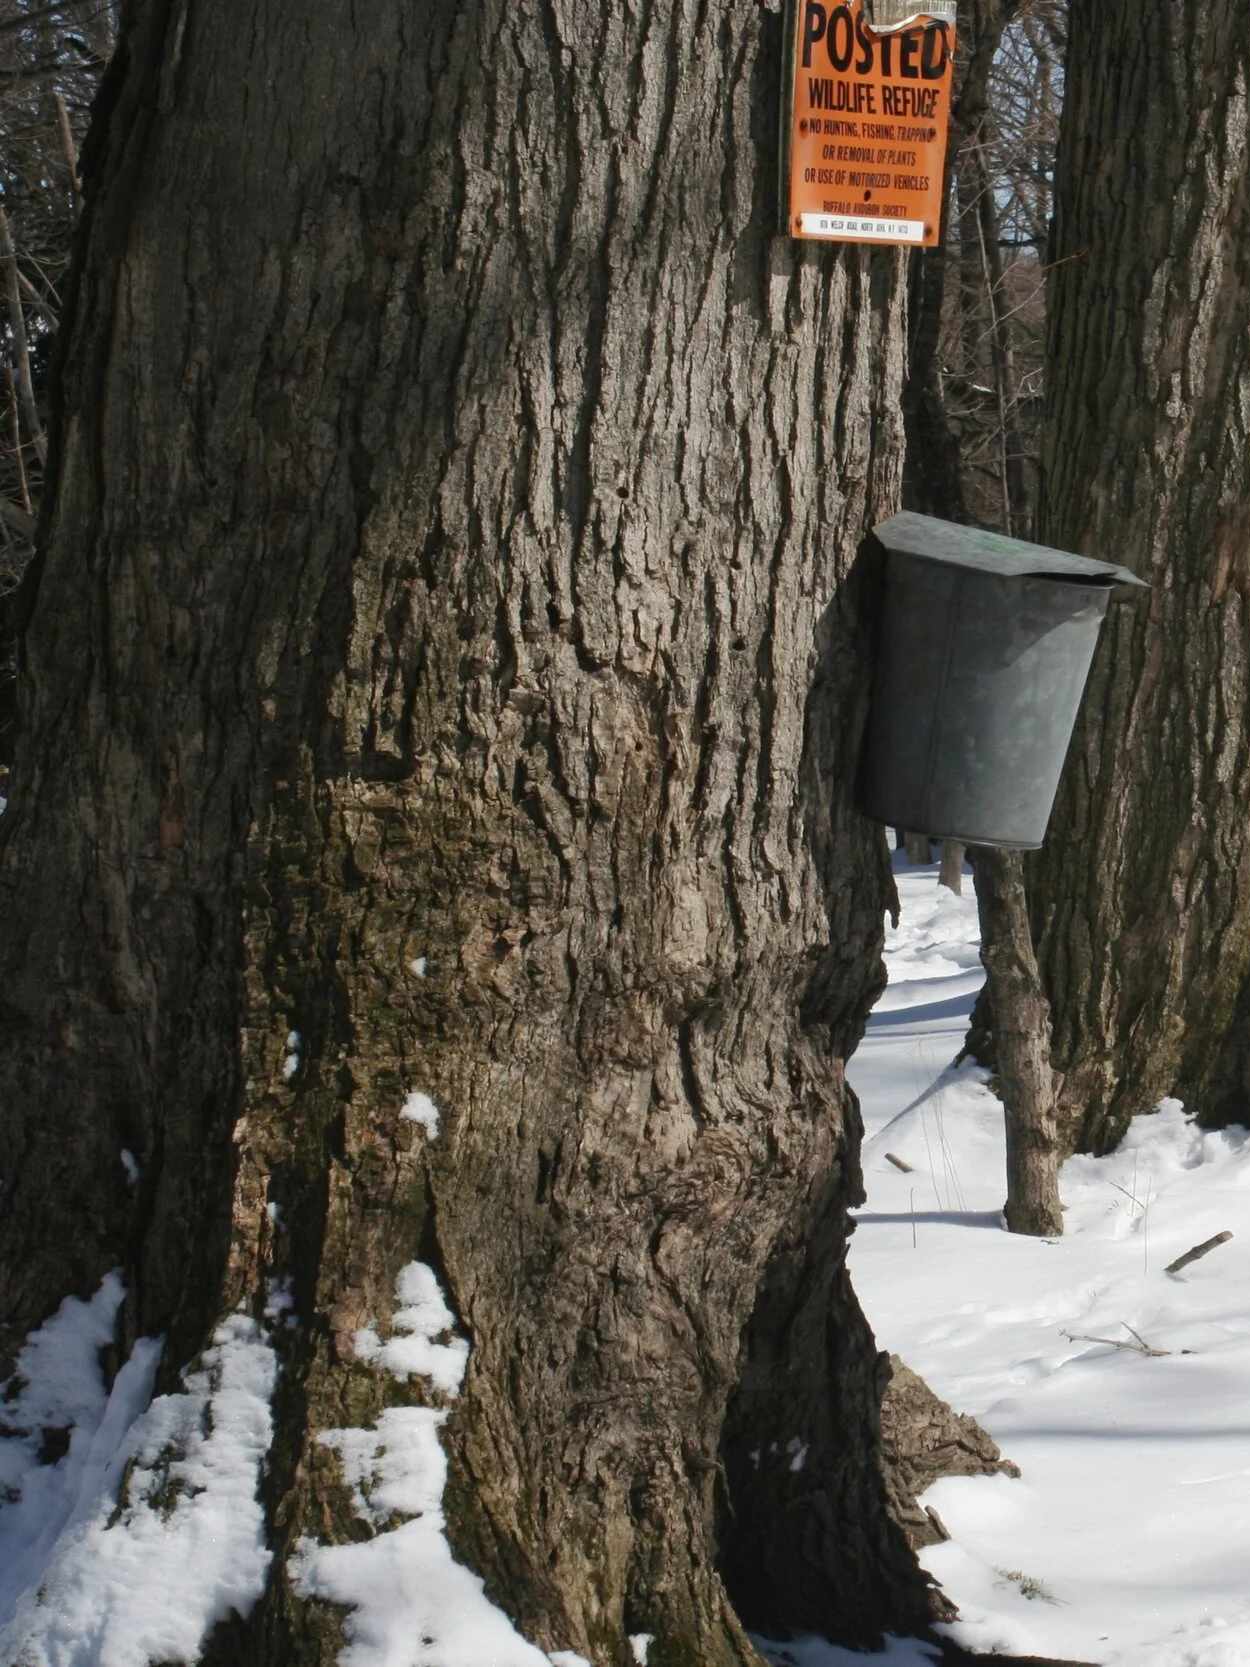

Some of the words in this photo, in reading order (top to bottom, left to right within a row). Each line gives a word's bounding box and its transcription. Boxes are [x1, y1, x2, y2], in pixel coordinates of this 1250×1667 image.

[802, 2, 949, 80] POSTED
[808, 77, 877, 114] WILDLIFE
[881, 85, 940, 118] REFUGE
[809, 118, 821, 134] NO
[823, 119, 860, 139] HUNTING,
[822, 144, 834, 160] OR
[837, 145, 875, 164] REMOVAL
[876, 149, 887, 164] OF
[887, 150, 916, 166] PLANTS
[804, 167, 816, 183] OR
[818, 168, 834, 184] USE
[835, 170, 846, 185] OF
[848, 171, 891, 188] MOTORIZED
[893, 173, 930, 191] VEHICLES
[823, 200, 850, 213] BUFFALO
[882, 204, 908, 217] SOCIETY
